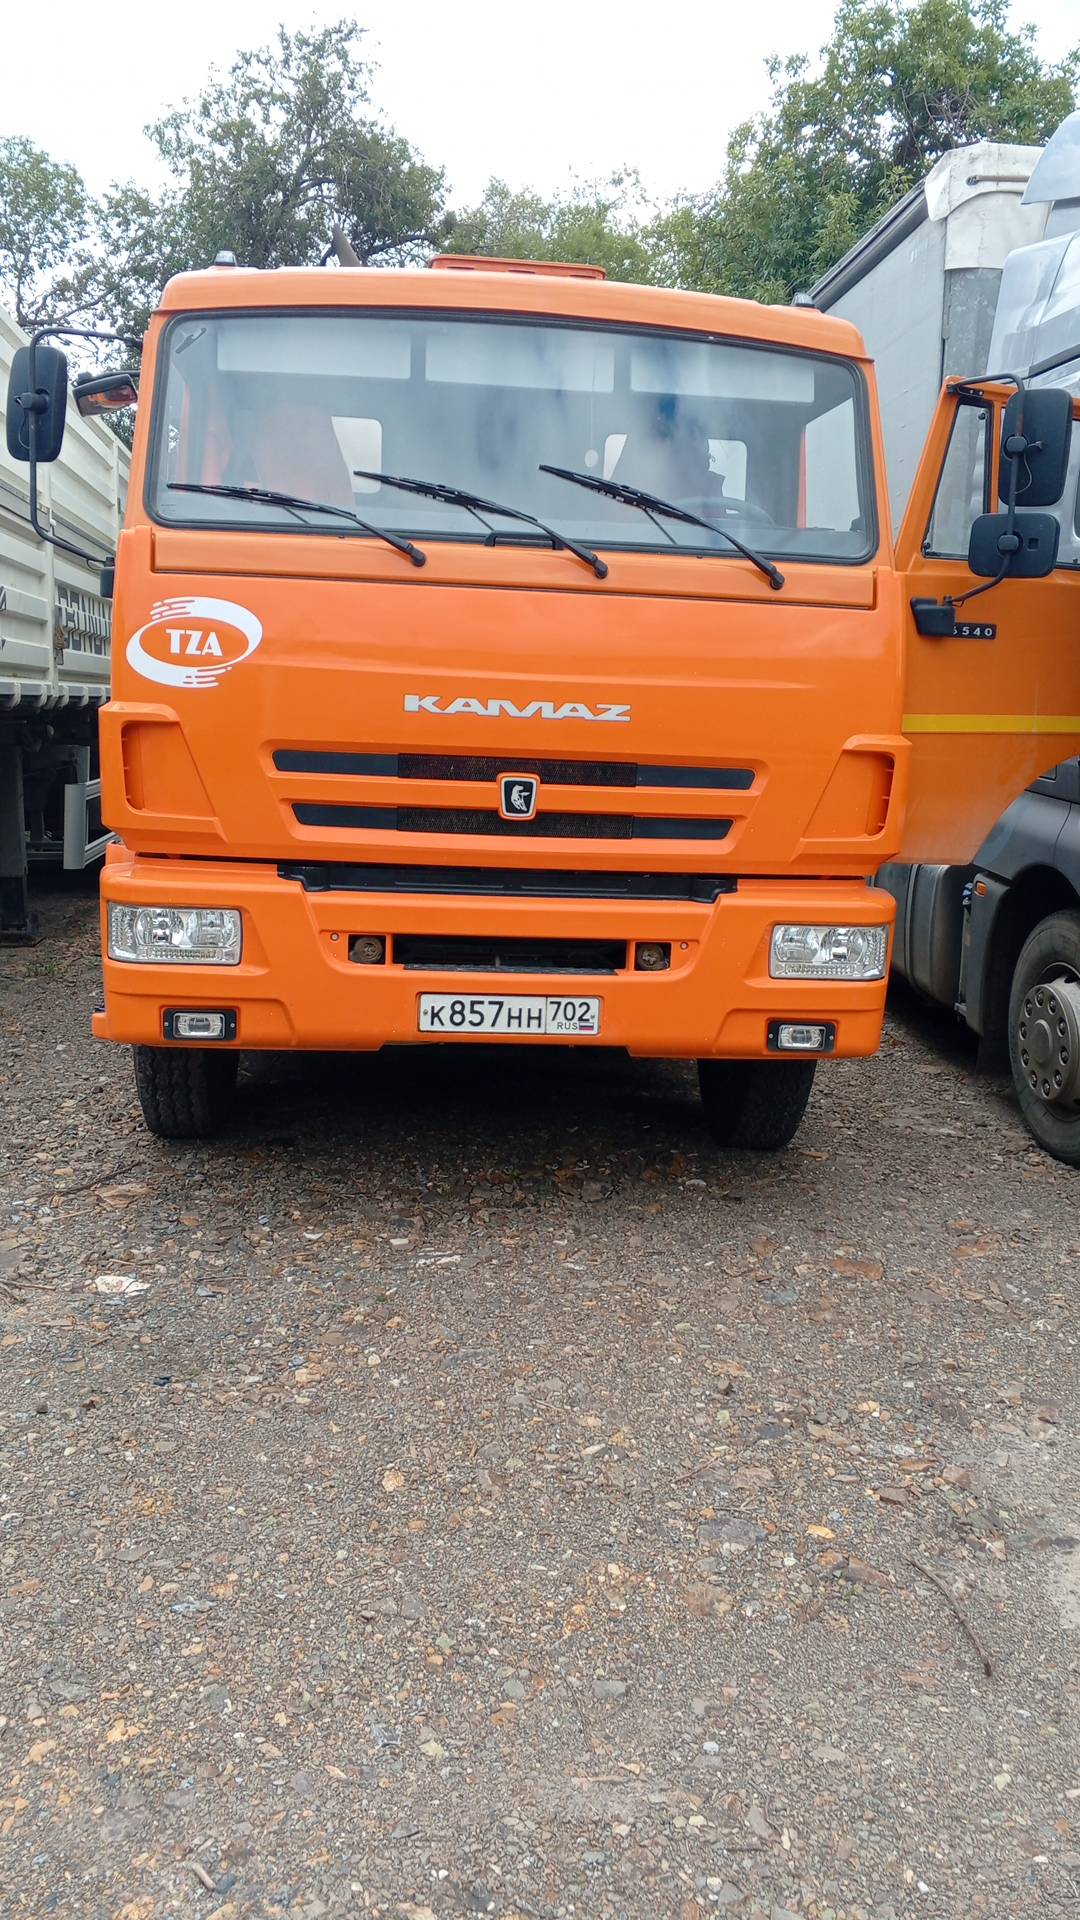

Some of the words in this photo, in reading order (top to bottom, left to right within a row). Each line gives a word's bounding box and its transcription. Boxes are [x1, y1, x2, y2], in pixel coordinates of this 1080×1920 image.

[165, 628, 223, 657] TZA
[403, 694, 631, 722] KAMAZ
[549, 1001, 591, 1022] 702
[557, 1022, 578, 1031] RUS
